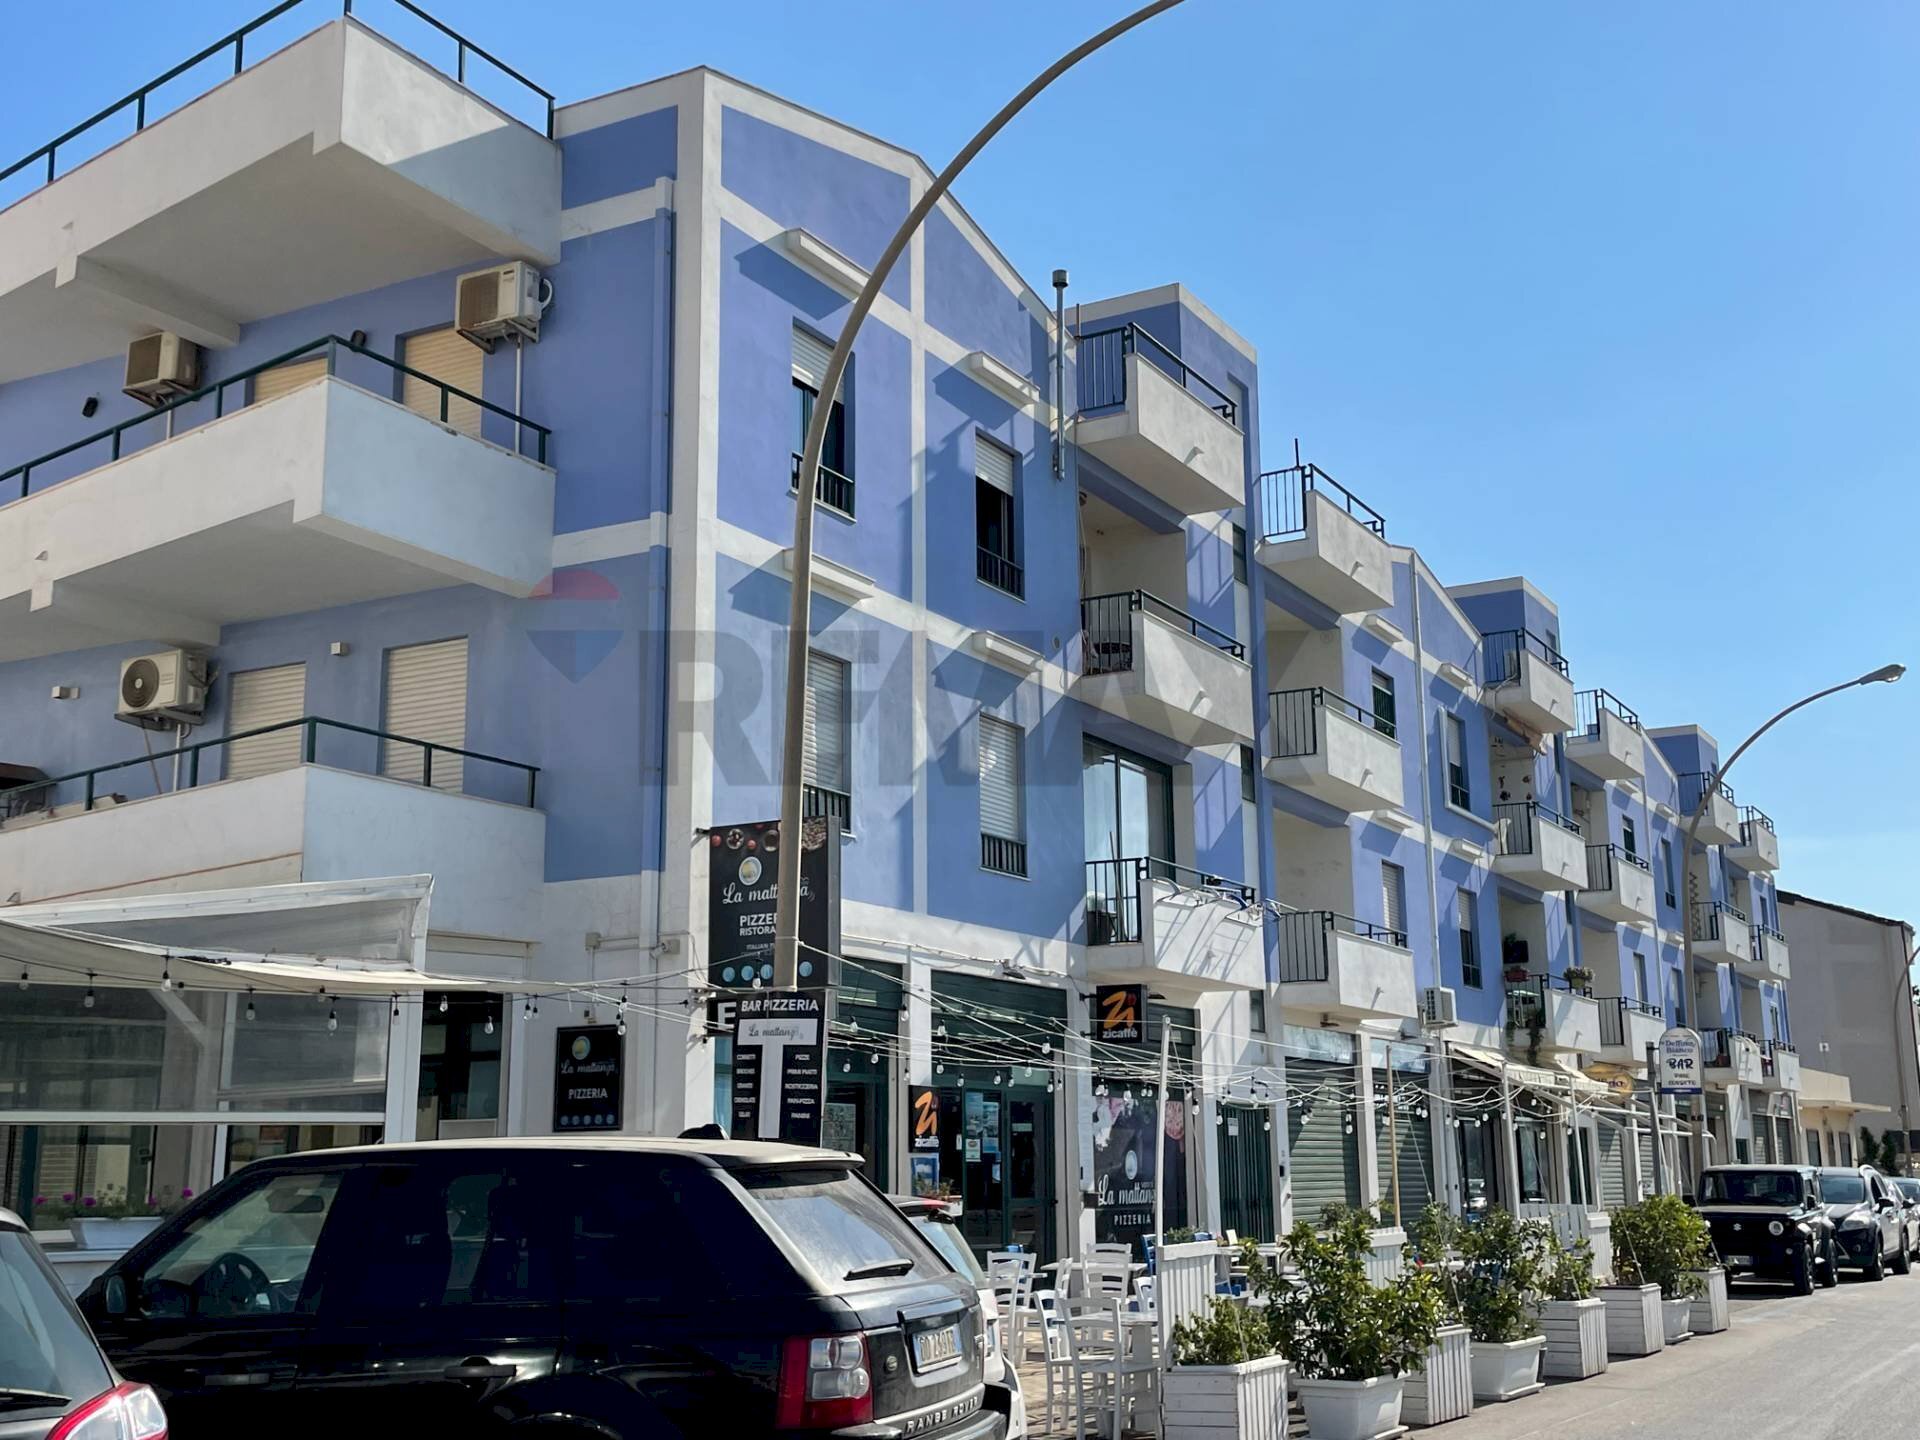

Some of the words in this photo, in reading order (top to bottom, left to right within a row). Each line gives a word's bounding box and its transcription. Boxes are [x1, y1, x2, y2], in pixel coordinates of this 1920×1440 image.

[722, 882, 743, 904] La
[749, 883, 809, 901] matta
[740, 913, 777, 927] PIZZE
[740, 926, 776, 936] RISTORA
[741, 1000, 761, 1012] BAR
[763, 999, 819, 1011] PIZZERIA
[749, 1025, 759, 1037] La
[561, 1060, 574, 1074] La
[1667, 1058, 1694, 1070] BAR
[568, 1088, 608, 1099] PIZZERIA
[1098, 1174, 1115, 1206] La
[1113, 1213, 1152, 1226] PIZZERIA
[906, 1409, 947, 1433] RANGE
